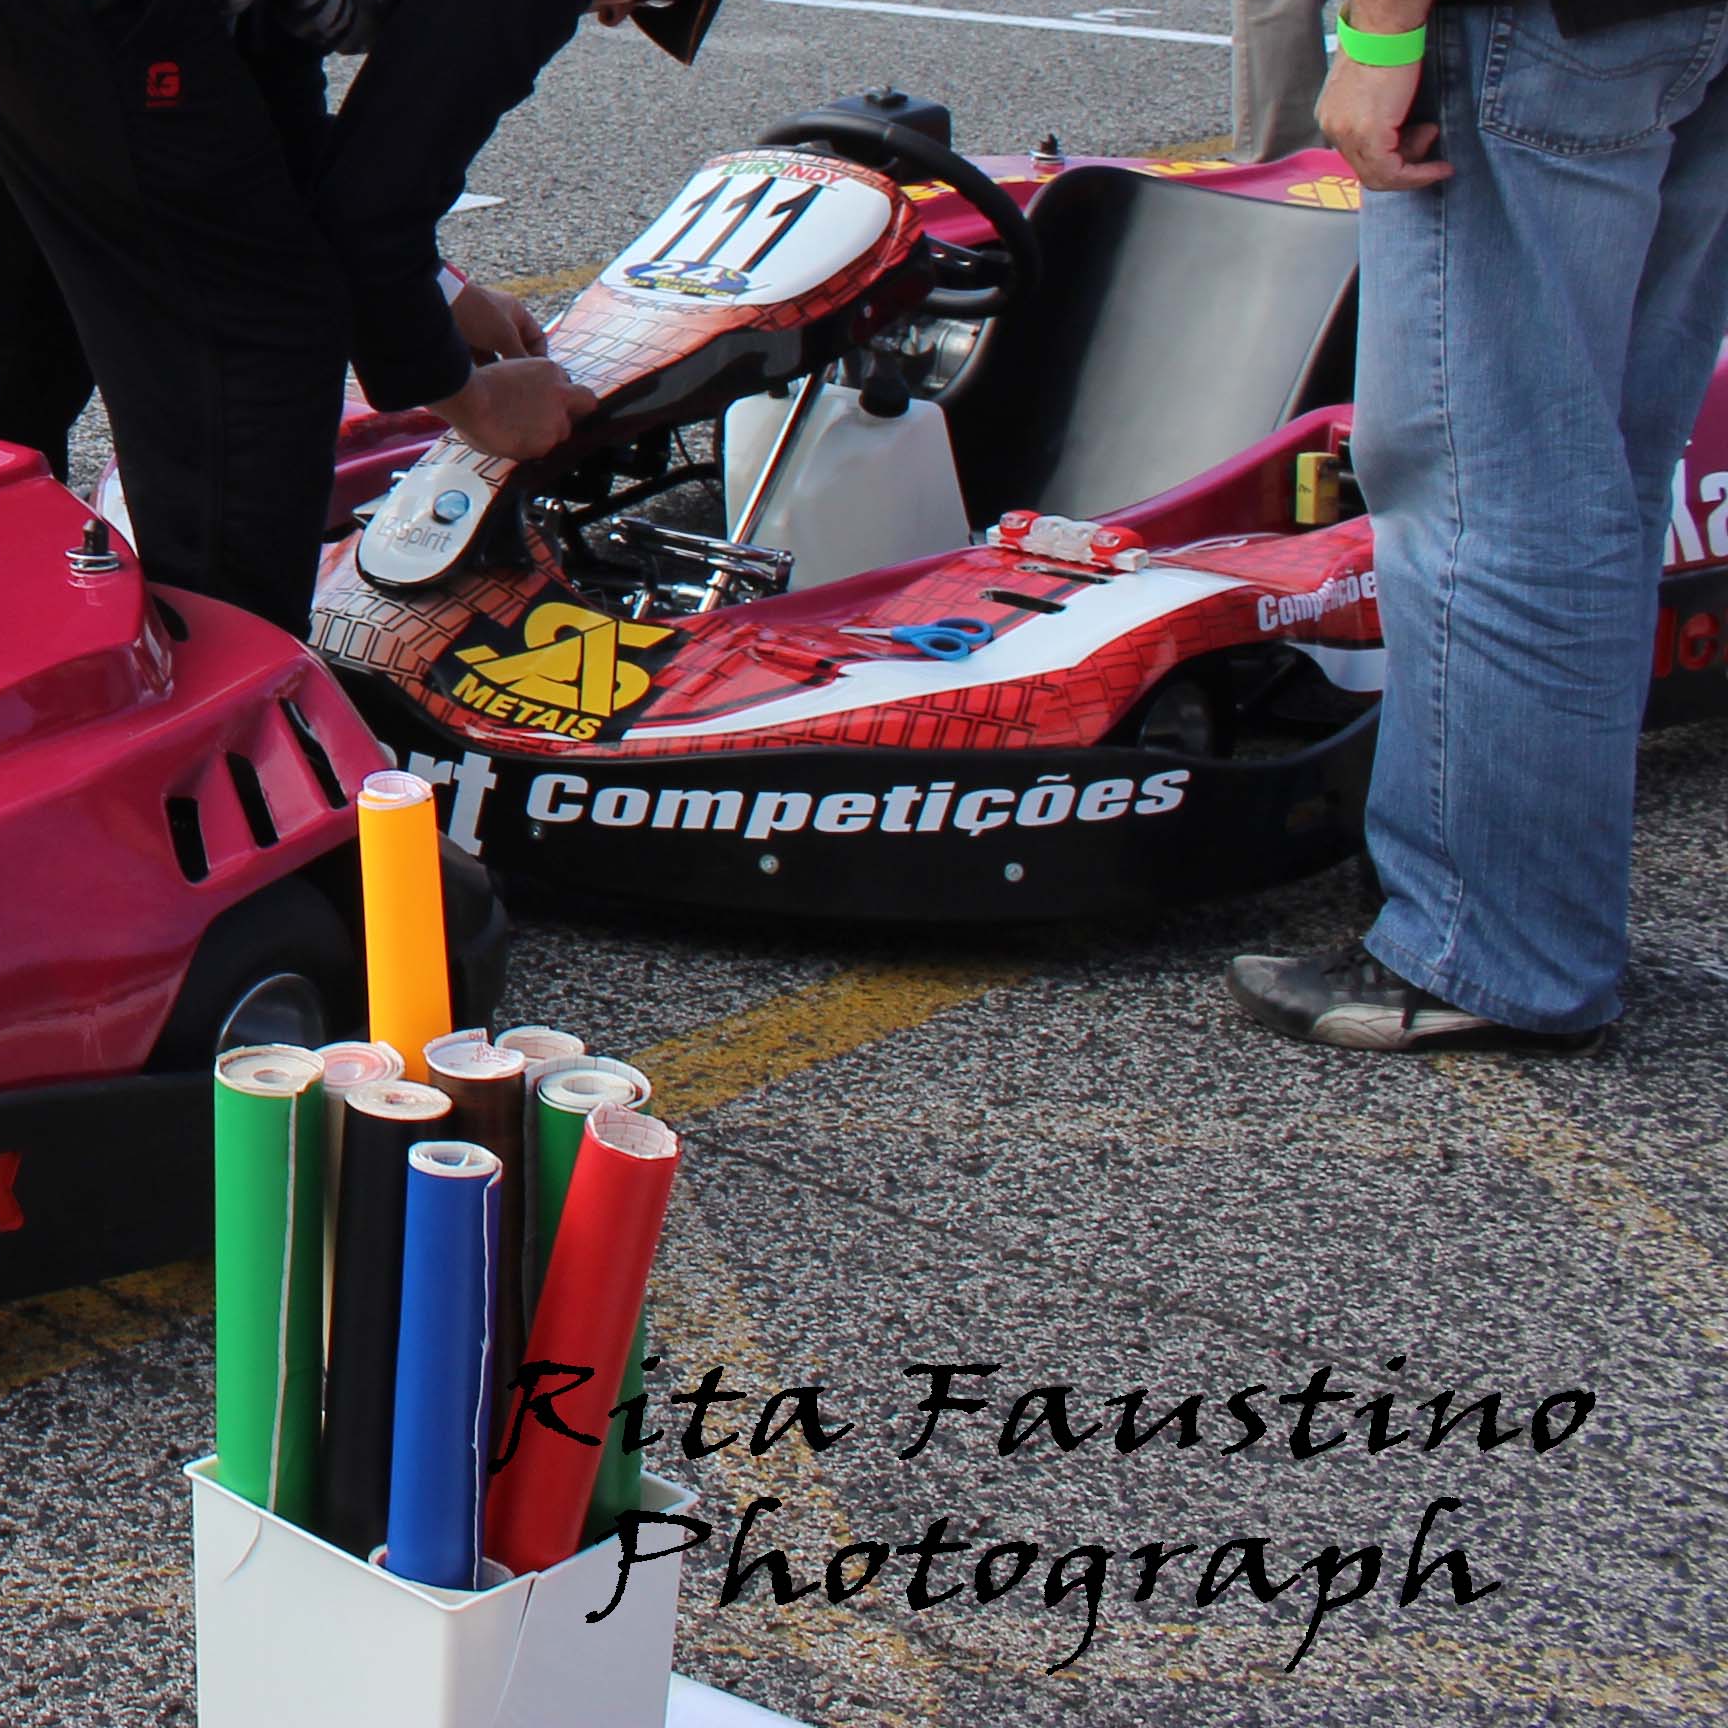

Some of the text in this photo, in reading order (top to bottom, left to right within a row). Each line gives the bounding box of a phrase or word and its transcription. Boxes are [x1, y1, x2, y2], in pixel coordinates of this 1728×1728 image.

[650, 175, 826, 273] 111
[636, 261, 723, 286] 24
[395, 519, 452, 553] Spirit
[450, 674, 603, 741] METAIS
[526, 769, 1192, 840] Competições
